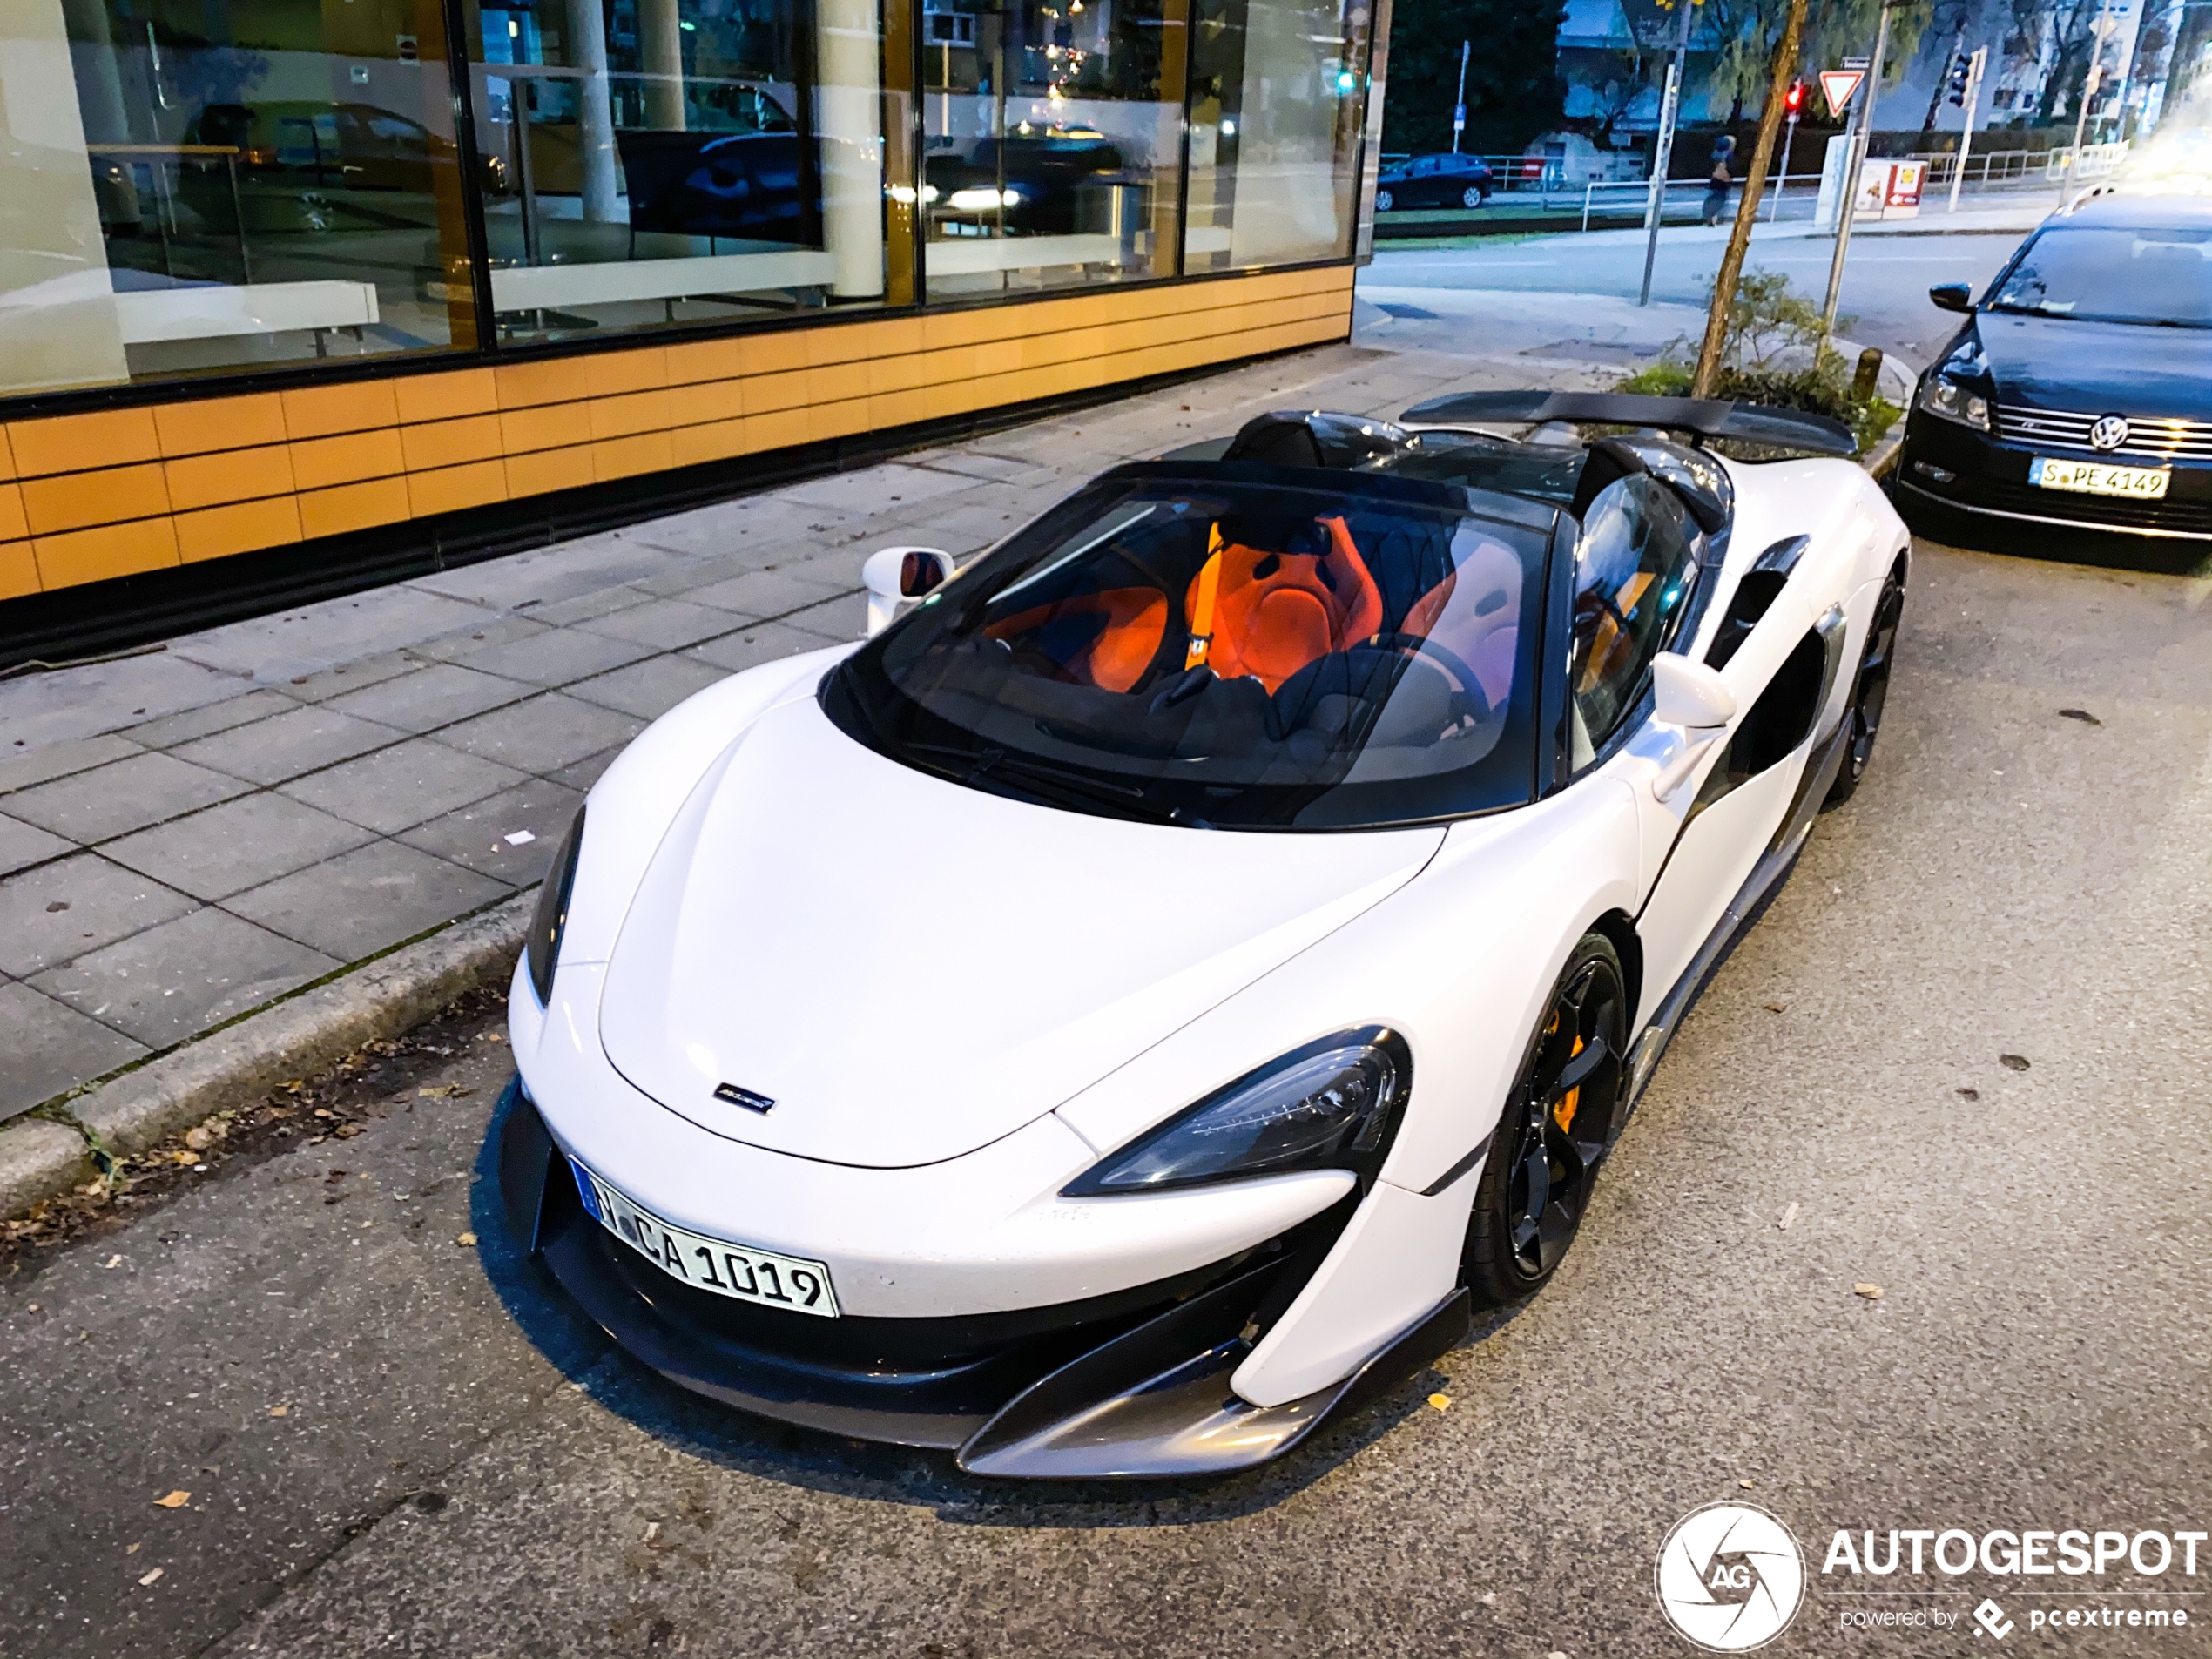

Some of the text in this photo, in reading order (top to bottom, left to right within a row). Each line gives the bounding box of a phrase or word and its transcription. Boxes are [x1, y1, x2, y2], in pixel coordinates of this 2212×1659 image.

[2044, 464, 2162, 493] S PE 4149
[590, 1177, 821, 1307] N CA 1019
